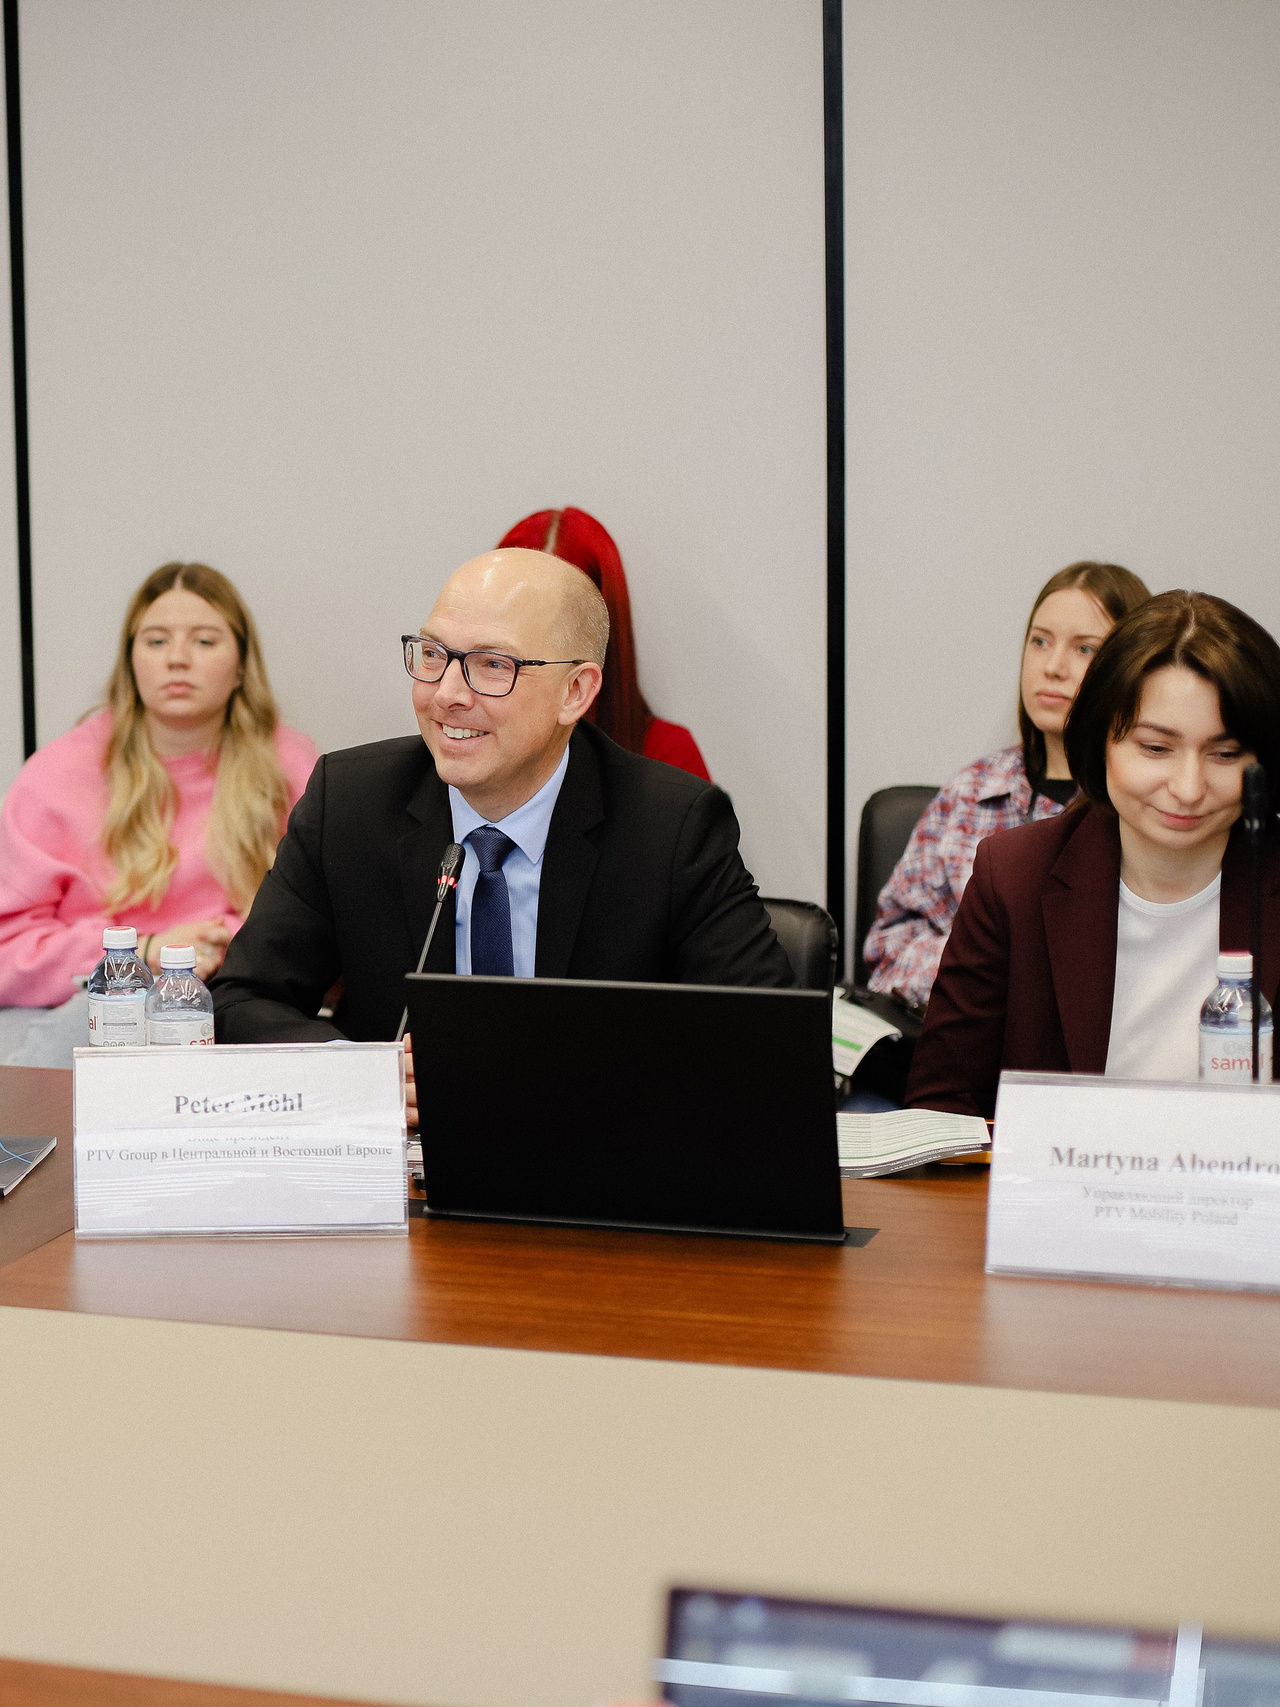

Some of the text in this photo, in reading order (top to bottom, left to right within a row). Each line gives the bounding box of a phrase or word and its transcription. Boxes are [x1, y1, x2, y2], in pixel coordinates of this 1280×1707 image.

[1211, 1052, 1265, 1071] saml
[173, 1092, 304, 1114] Peter Möhl
[86, 1149, 115, 1162] PTV
[118, 1149, 158, 1163] Group
[172, 1147, 257, 1161] Центральной
[273, 1145, 343, 1157] Восточной
[346, 1144, 394, 1158] Европе
[1049, 1146, 1160, 1176] Martyna
[1094, 1206, 1123, 1218] PTV
[1191, 1211, 1239, 1226] Poland
